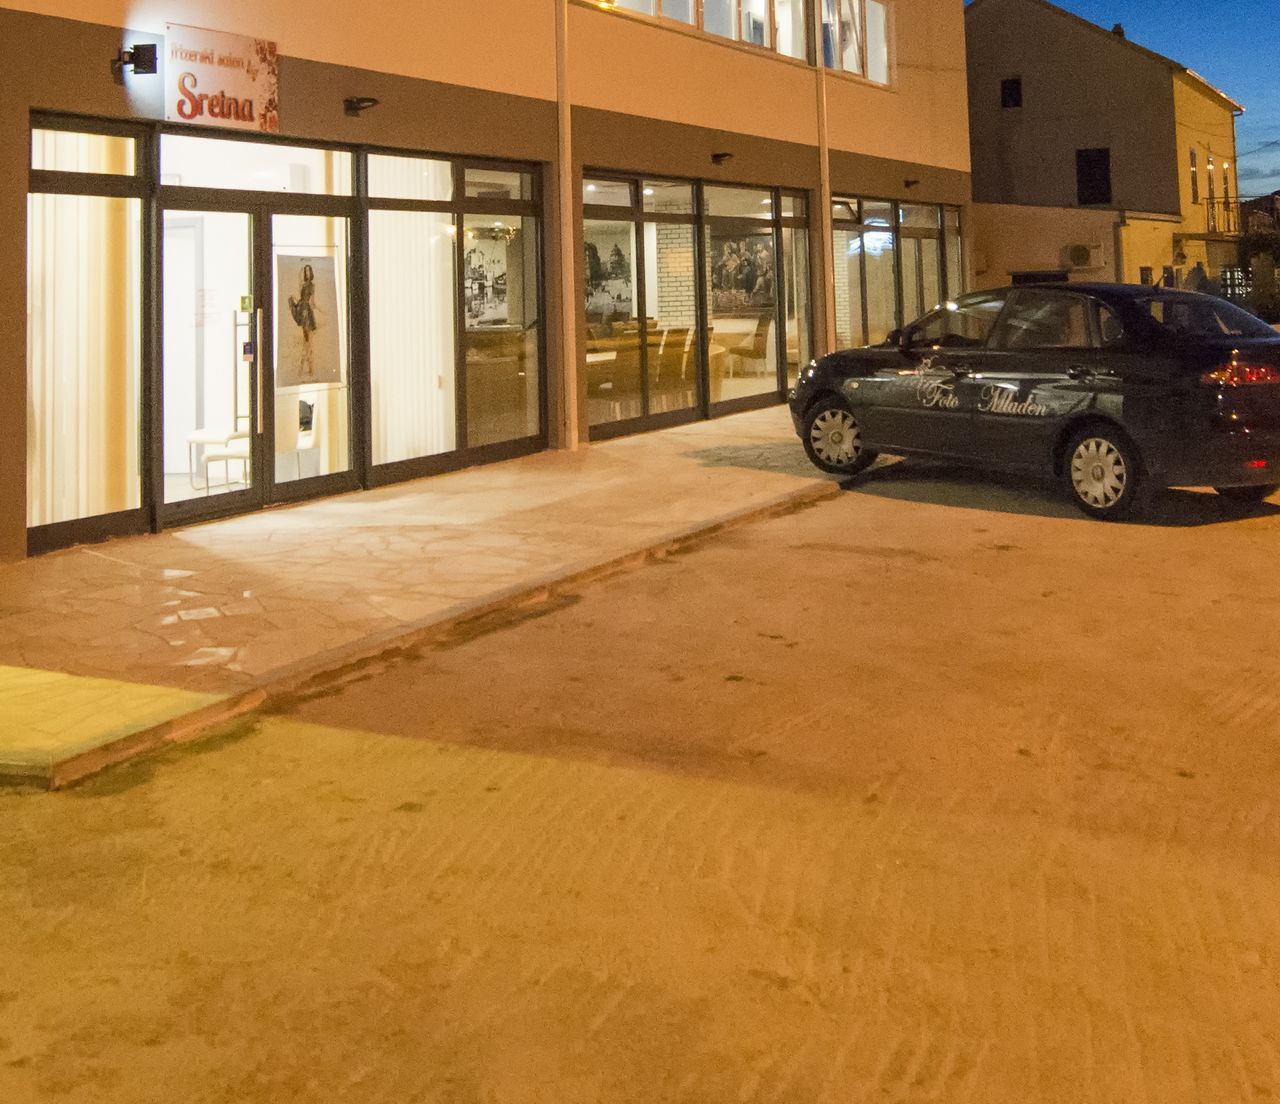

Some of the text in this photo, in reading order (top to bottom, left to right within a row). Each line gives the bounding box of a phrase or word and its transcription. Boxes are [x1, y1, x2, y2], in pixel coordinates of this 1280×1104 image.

[177, 72, 255, 123] Sretna
[922, 380, 1047, 416] Foto Mladen
